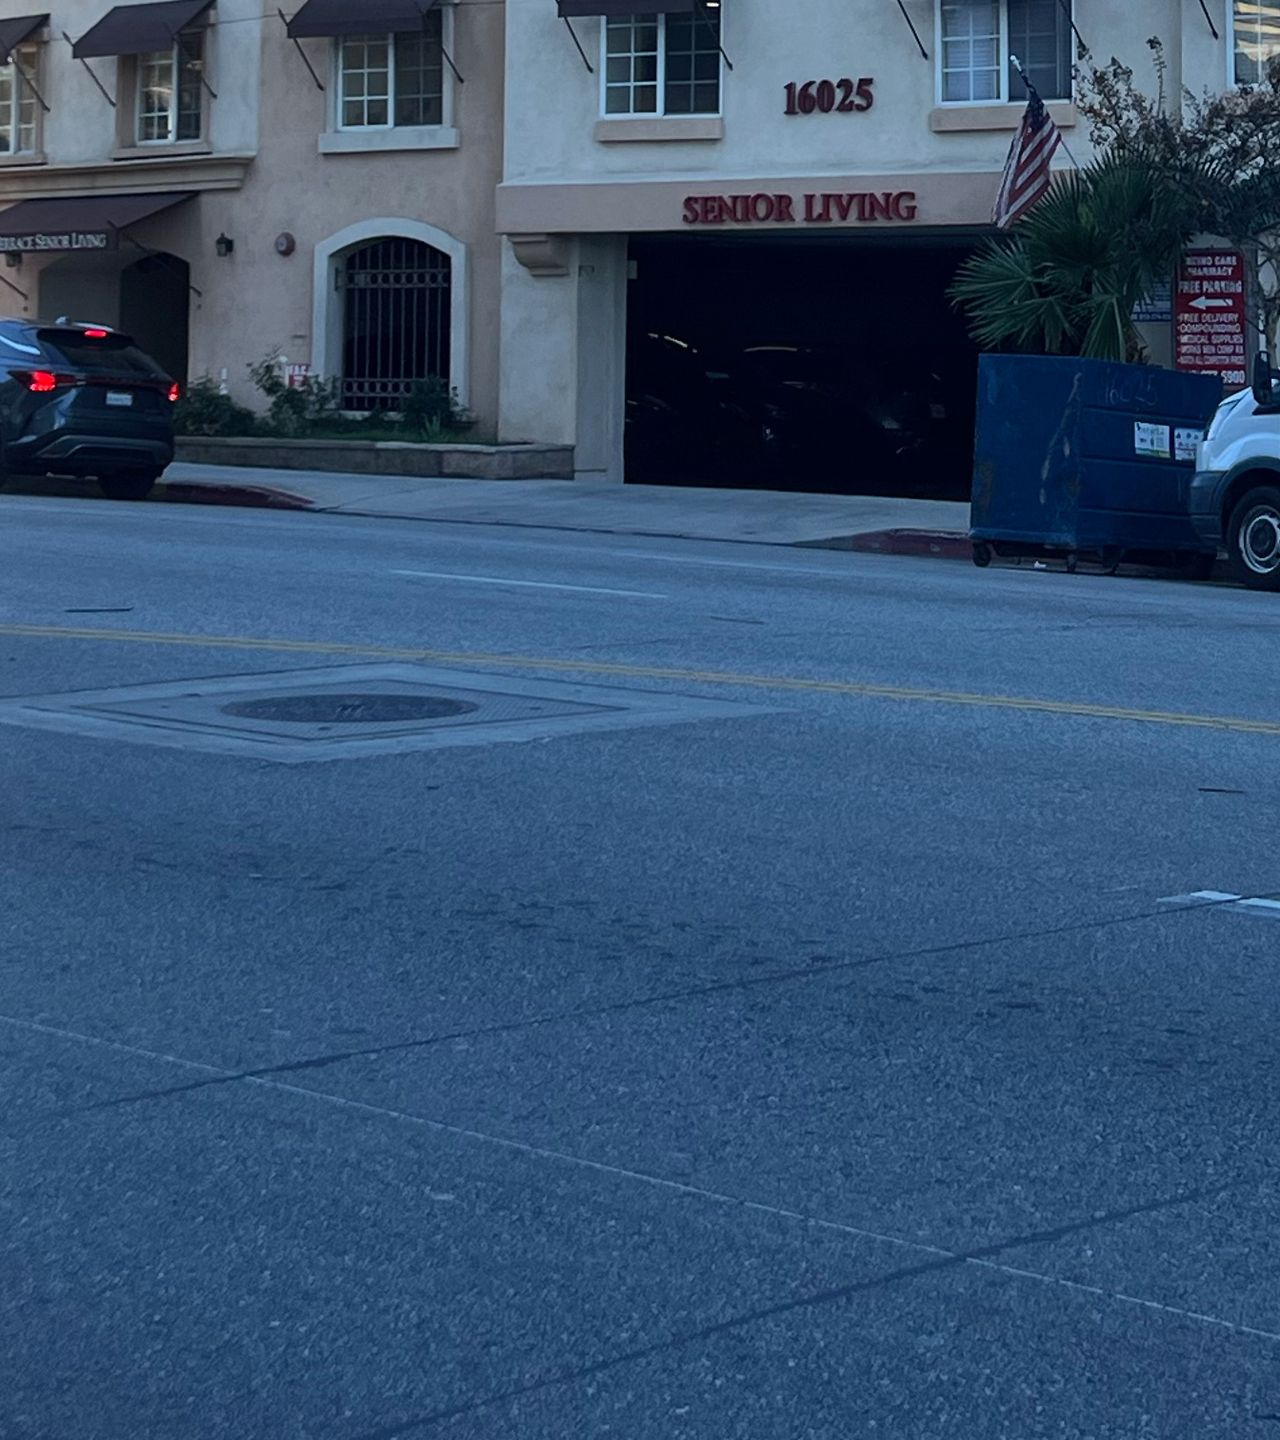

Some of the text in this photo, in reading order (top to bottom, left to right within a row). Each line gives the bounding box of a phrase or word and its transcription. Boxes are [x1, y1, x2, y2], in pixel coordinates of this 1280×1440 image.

[784, 78, 874, 115] 16025
[683, 191, 917, 224] SENIOR LIVING
[35, 233, 70, 249] SENIOR
[71, 232, 107, 248] LIVING
[1178, 280, 1200, 294] FREE
